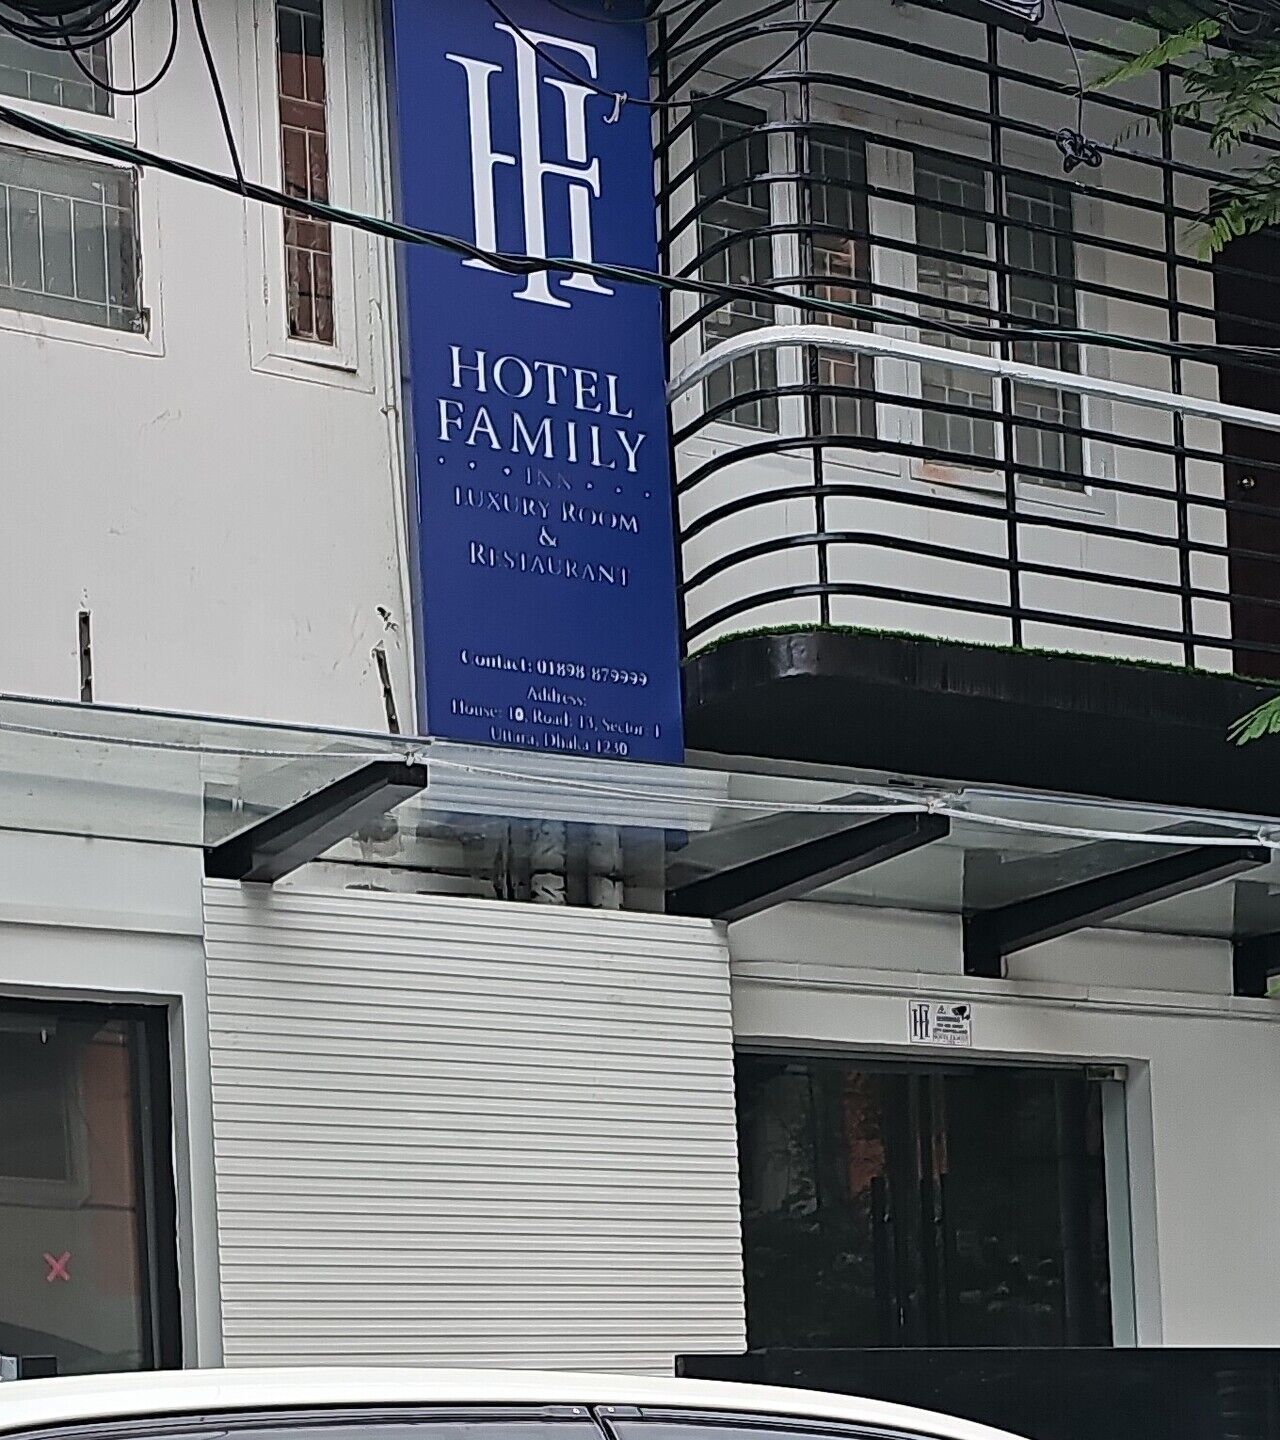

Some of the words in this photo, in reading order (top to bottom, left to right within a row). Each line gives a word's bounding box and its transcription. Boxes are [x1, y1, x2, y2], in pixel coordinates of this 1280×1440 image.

[448, 344, 634, 419] HOTEL
[437, 398, 646, 473] FAMILY
[526, 466, 572, 491] INN
[455, 486, 550, 519] LUXURY
[561, 501, 639, 533] ROOM
[539, 525, 557, 547] &
[470, 541, 631, 586] RESTAURANT
[536, 660, 586, 680] 01898
[591, 666, 648, 686] 879999
